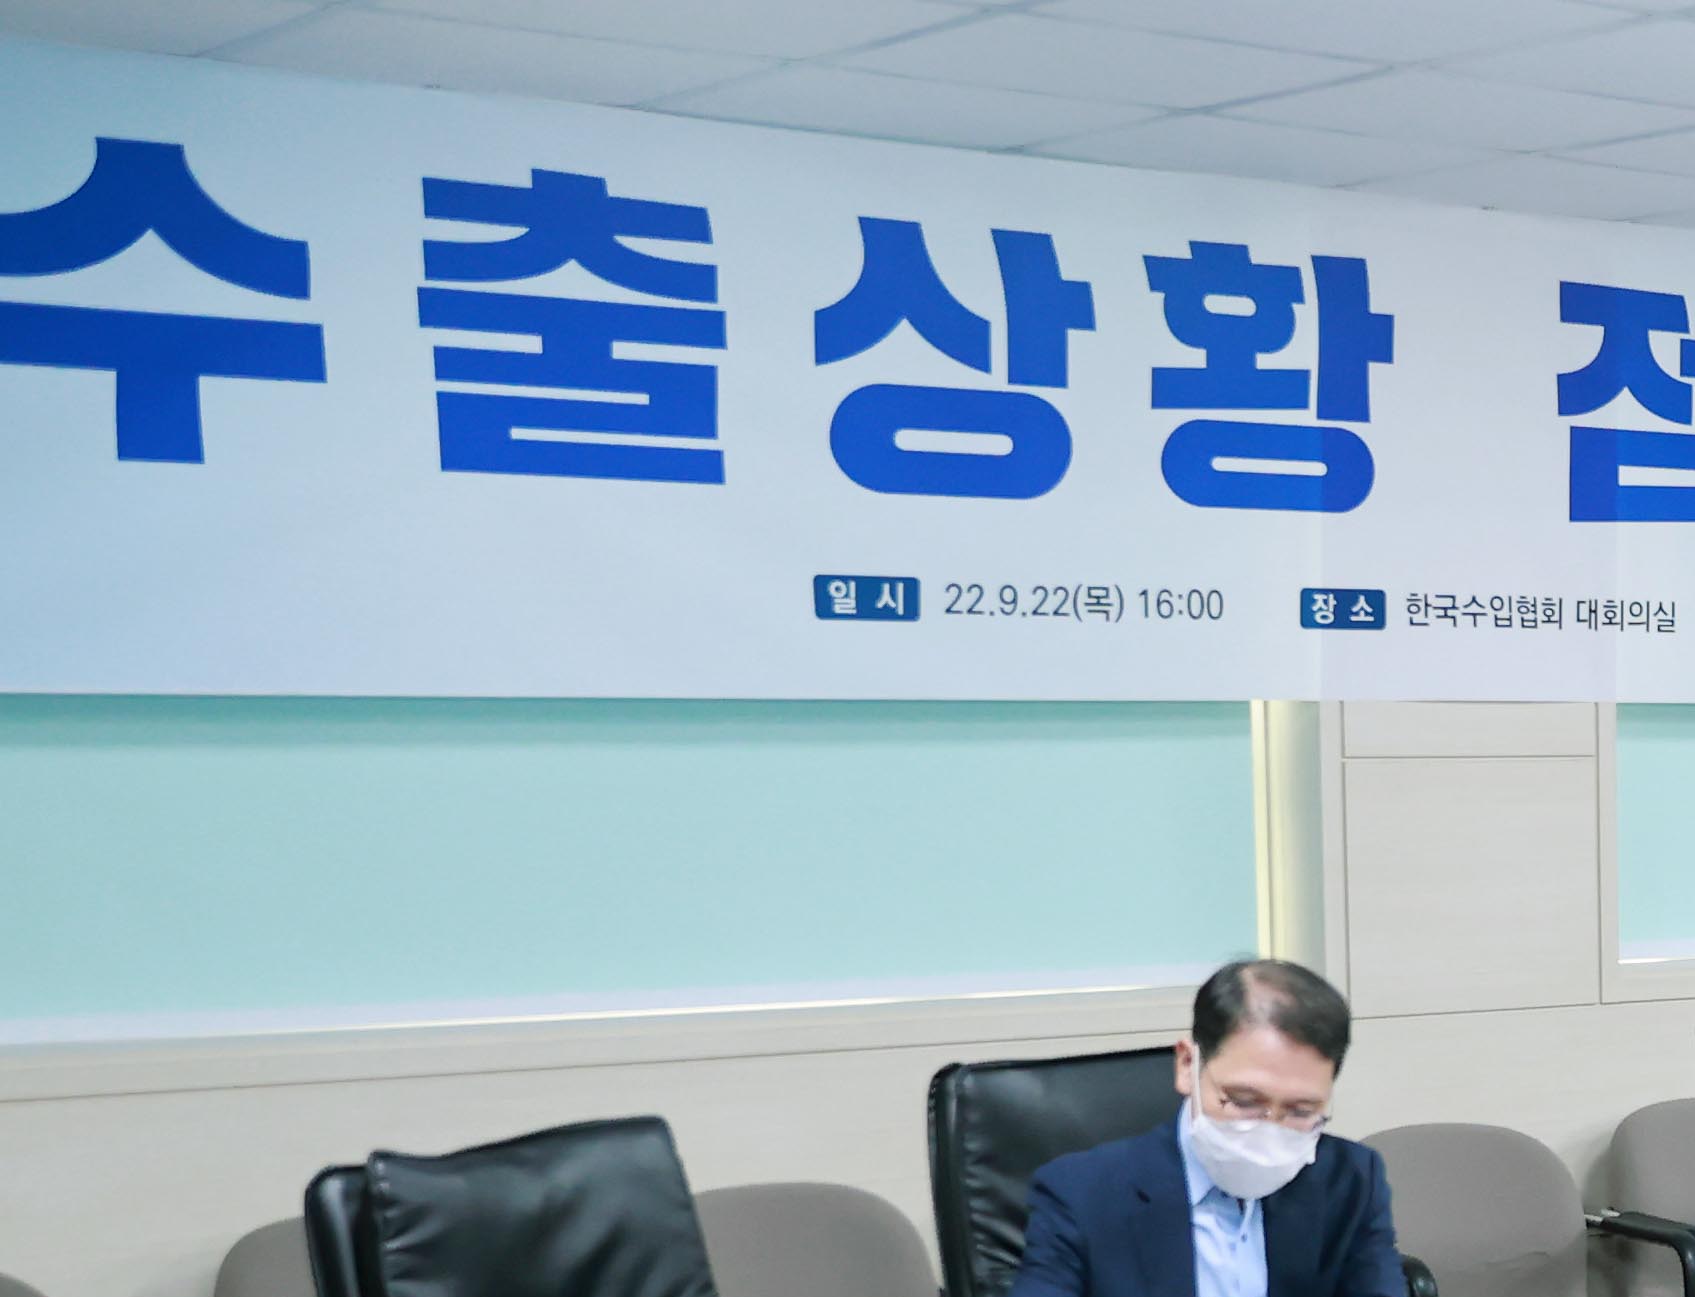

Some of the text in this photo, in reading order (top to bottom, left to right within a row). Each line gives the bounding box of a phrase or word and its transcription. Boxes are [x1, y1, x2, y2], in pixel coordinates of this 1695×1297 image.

[0, 134, 1395, 514] 수출상황
[944, 582, 1125, 623] 22.9.22(목)
[1138, 588, 1225, 620] 16:00
[1405, 593, 1564, 631] 한국수입협회
[1576, 598, 1676, 633] 대회의실
